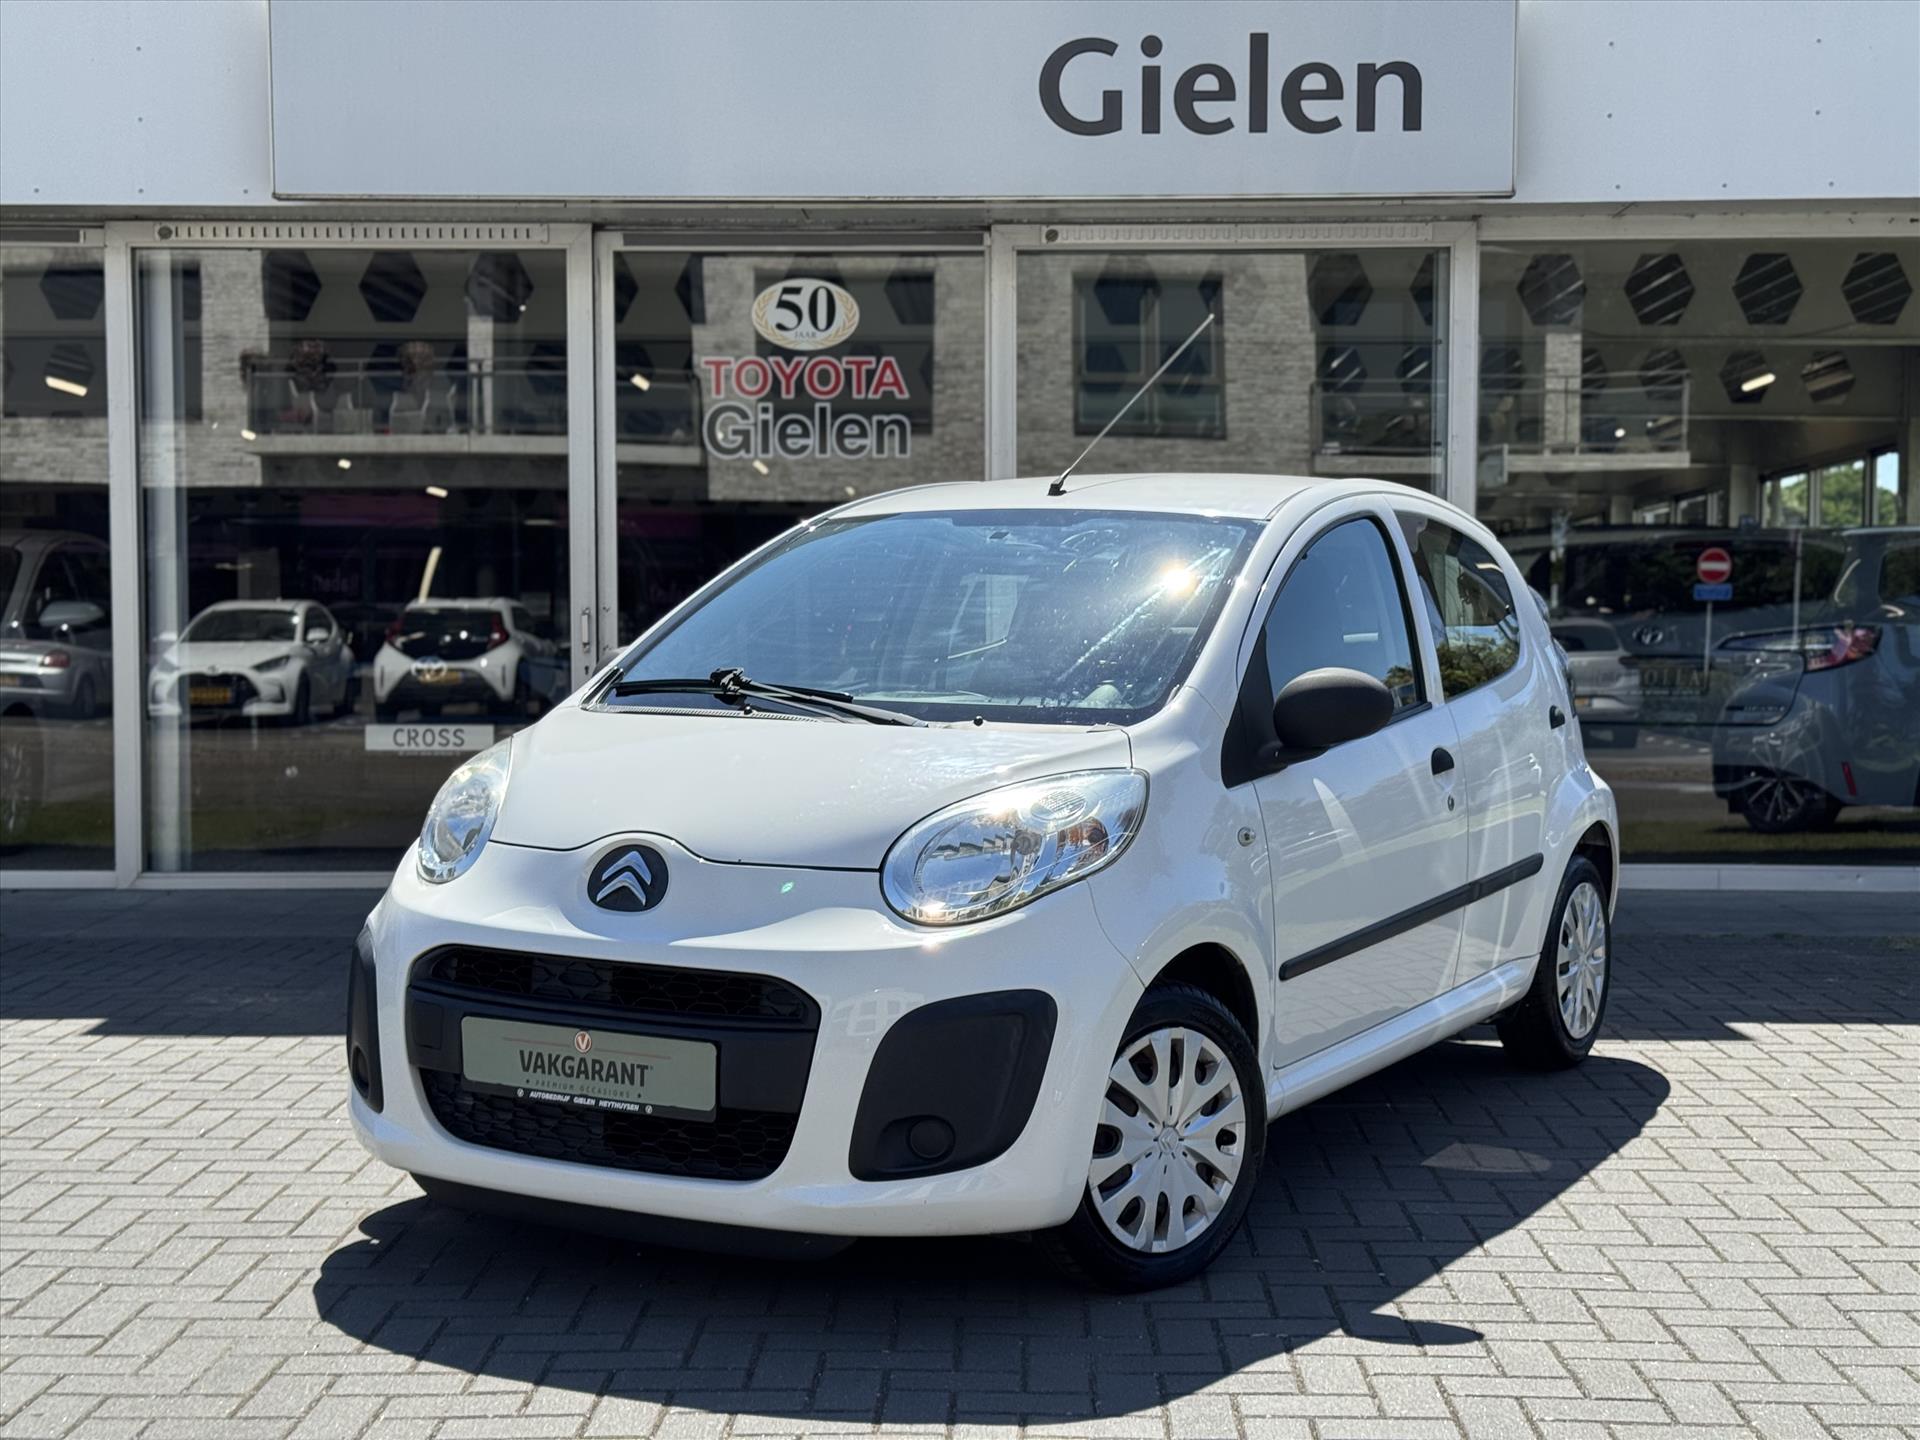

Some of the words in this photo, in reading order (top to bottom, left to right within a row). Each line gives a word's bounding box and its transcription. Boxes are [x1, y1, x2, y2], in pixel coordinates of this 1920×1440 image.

[1039, 33, 1423, 136] Gielen
[775, 286, 836, 332] 50
[794, 330, 817, 339] JAAR
[702, 357, 909, 399] TOYOTA
[703, 402, 911, 459] Gielen
[393, 728, 465, 747] CROSS
[519, 1049, 649, 1087] VAKGARANT
[529, 1090, 571, 1102] AUTOBEDRIJF
[573, 1096, 596, 1106] GIELEN
[598, 1099, 640, 1112] HEYTHUYSEN
[535, 1079, 575, 1090] PREMIUM
[579, 1085, 631, 1098] OCCASIONS
